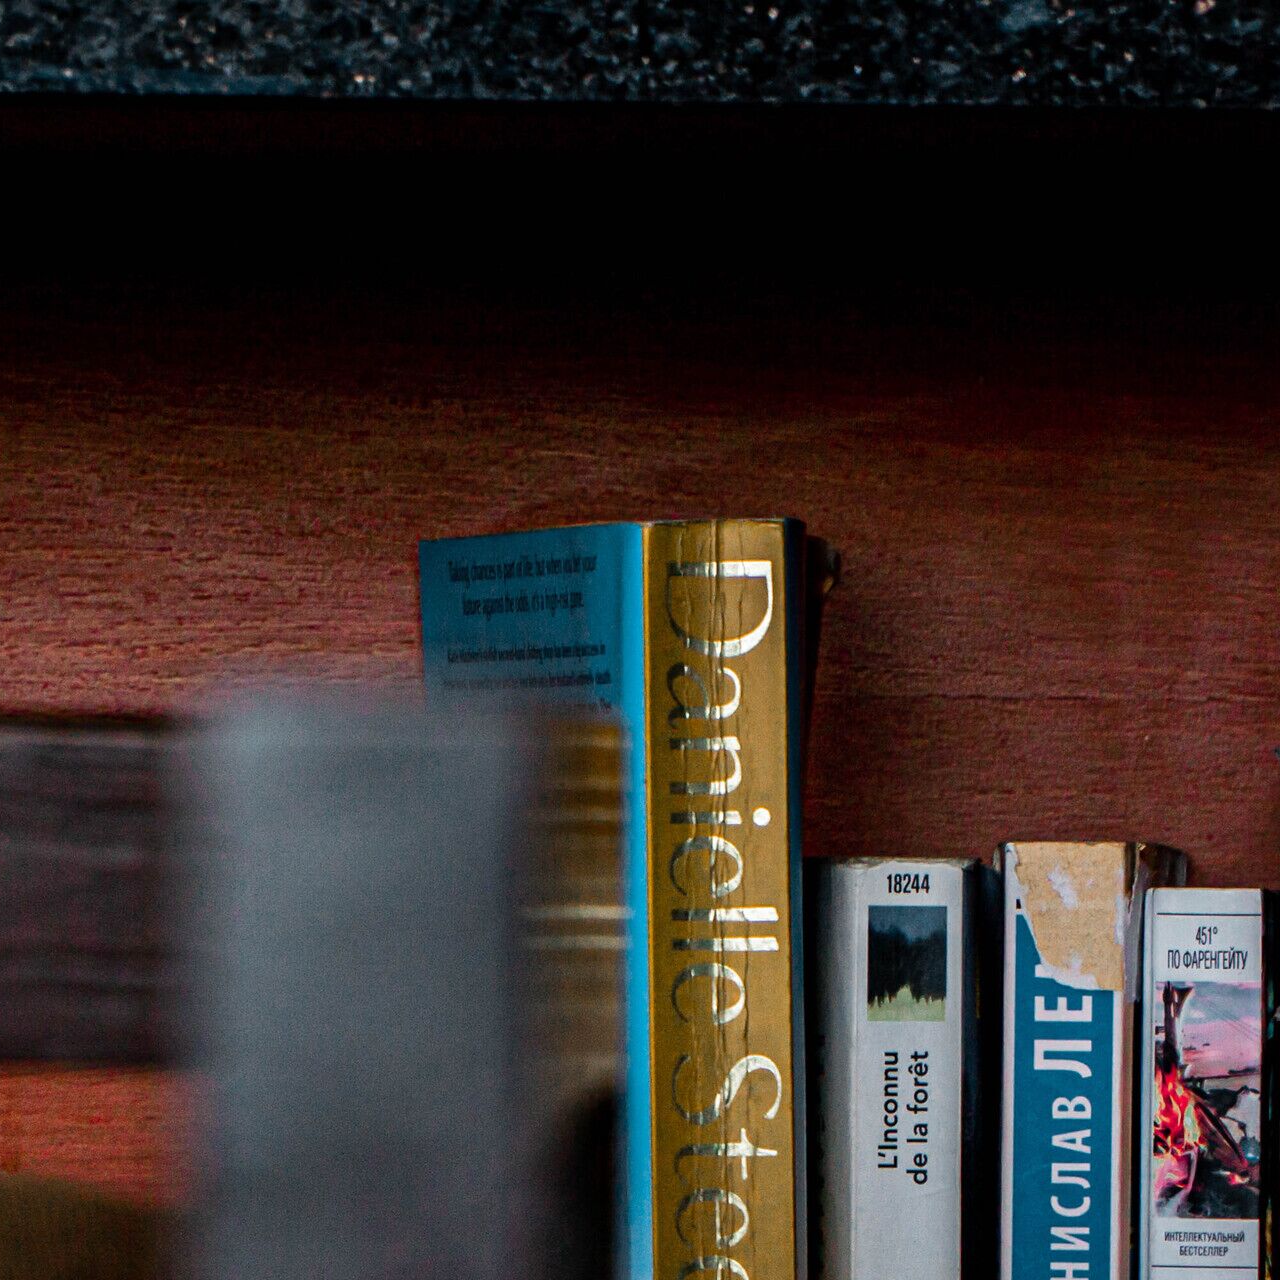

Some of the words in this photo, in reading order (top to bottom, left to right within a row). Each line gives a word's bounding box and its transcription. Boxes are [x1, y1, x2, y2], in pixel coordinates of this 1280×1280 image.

[667, 560, 780, 1026] Danielle
[886, 873, 930, 894] 18244
[1195, 926, 1218, 945] 451°
[1167, 949, 1181, 969] ПО
[1182, 946, 1249, 970] ФАРЕНГЕЙТУ
[1033, 964, 1093, 1079] ЛЕ
[906, 1051, 929, 1115] forêt
[907, 1123, 928, 1144] la
[906, 1153, 928, 1185] de
[1164, 1230, 1245, 1243] ИНТЕЛЛЕКТУАЛЬНЫЙ
[1179, 1244, 1229, 1257] БЕСТСЕЛЛЕР
